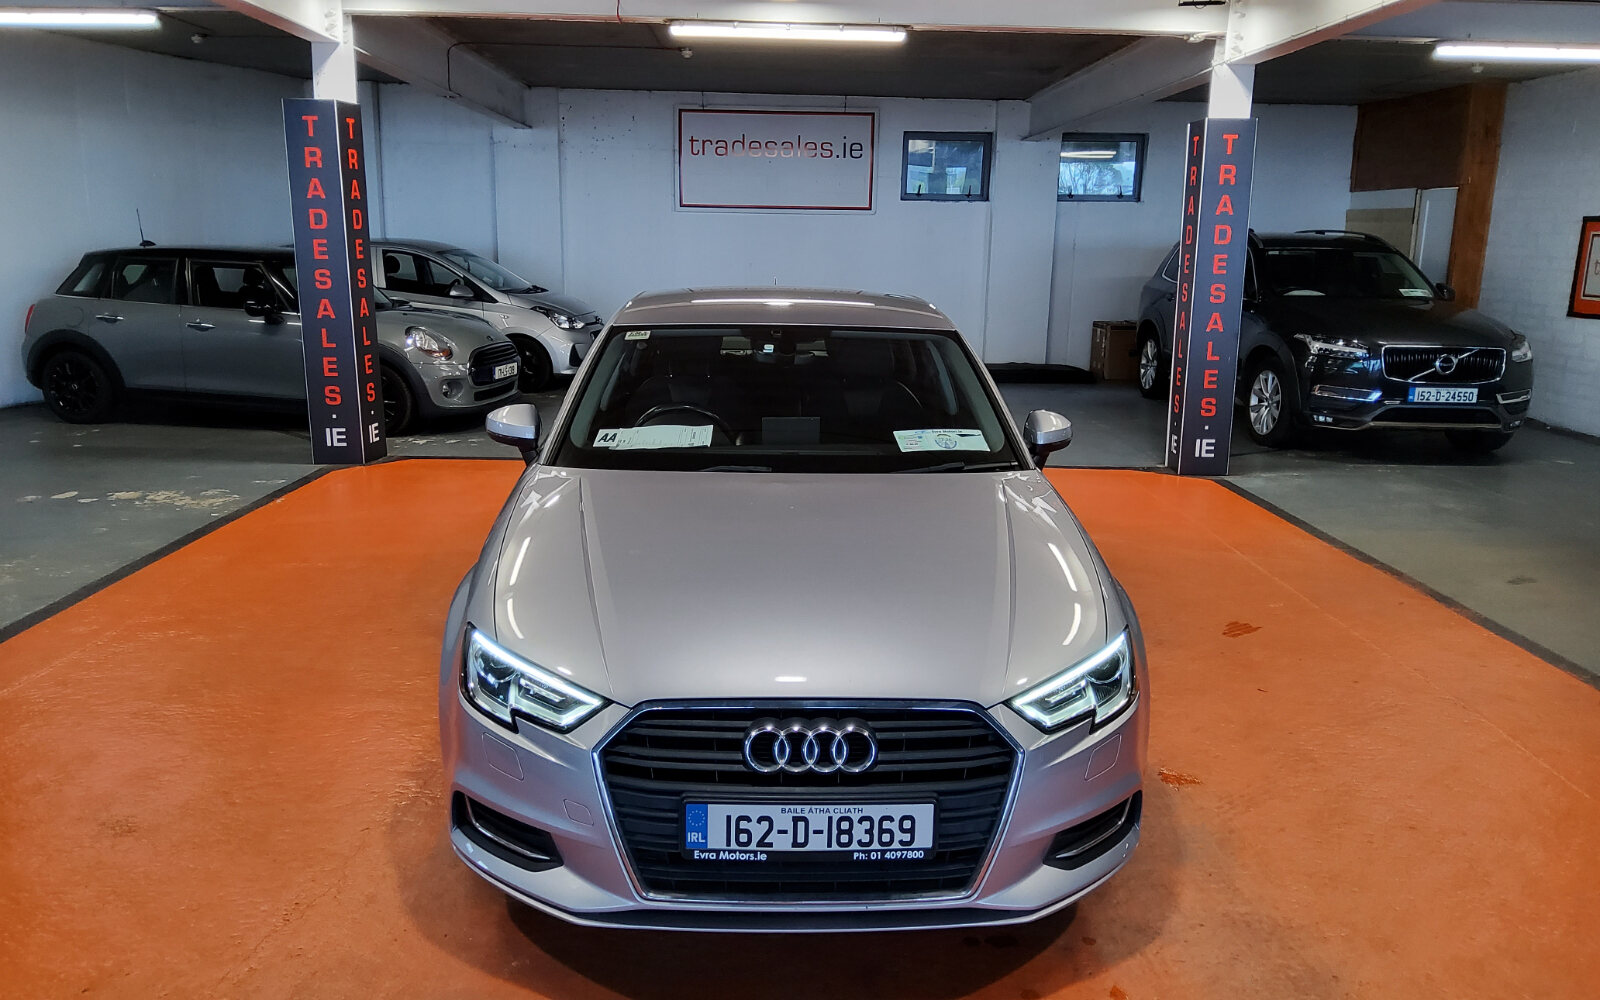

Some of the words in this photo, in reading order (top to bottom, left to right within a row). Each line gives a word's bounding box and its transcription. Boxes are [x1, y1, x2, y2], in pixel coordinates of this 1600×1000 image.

[689, 134, 863, 159] tradesales.ie
[1416, 391, 1474, 401] 152-D-24550
[598, 433, 617, 442] AA
[808, 806, 831, 814] ÁTHA
[725, 815, 916, 848] 162-D-18369
[687, 832, 705, 843] IRL
[694, 850, 716, 860] Evra
[719, 850, 768, 861] Motors.ie
[853, 852, 868, 860] Ph:
[870, 851, 881, 860] 01
[884, 850, 925, 860] 4097800
